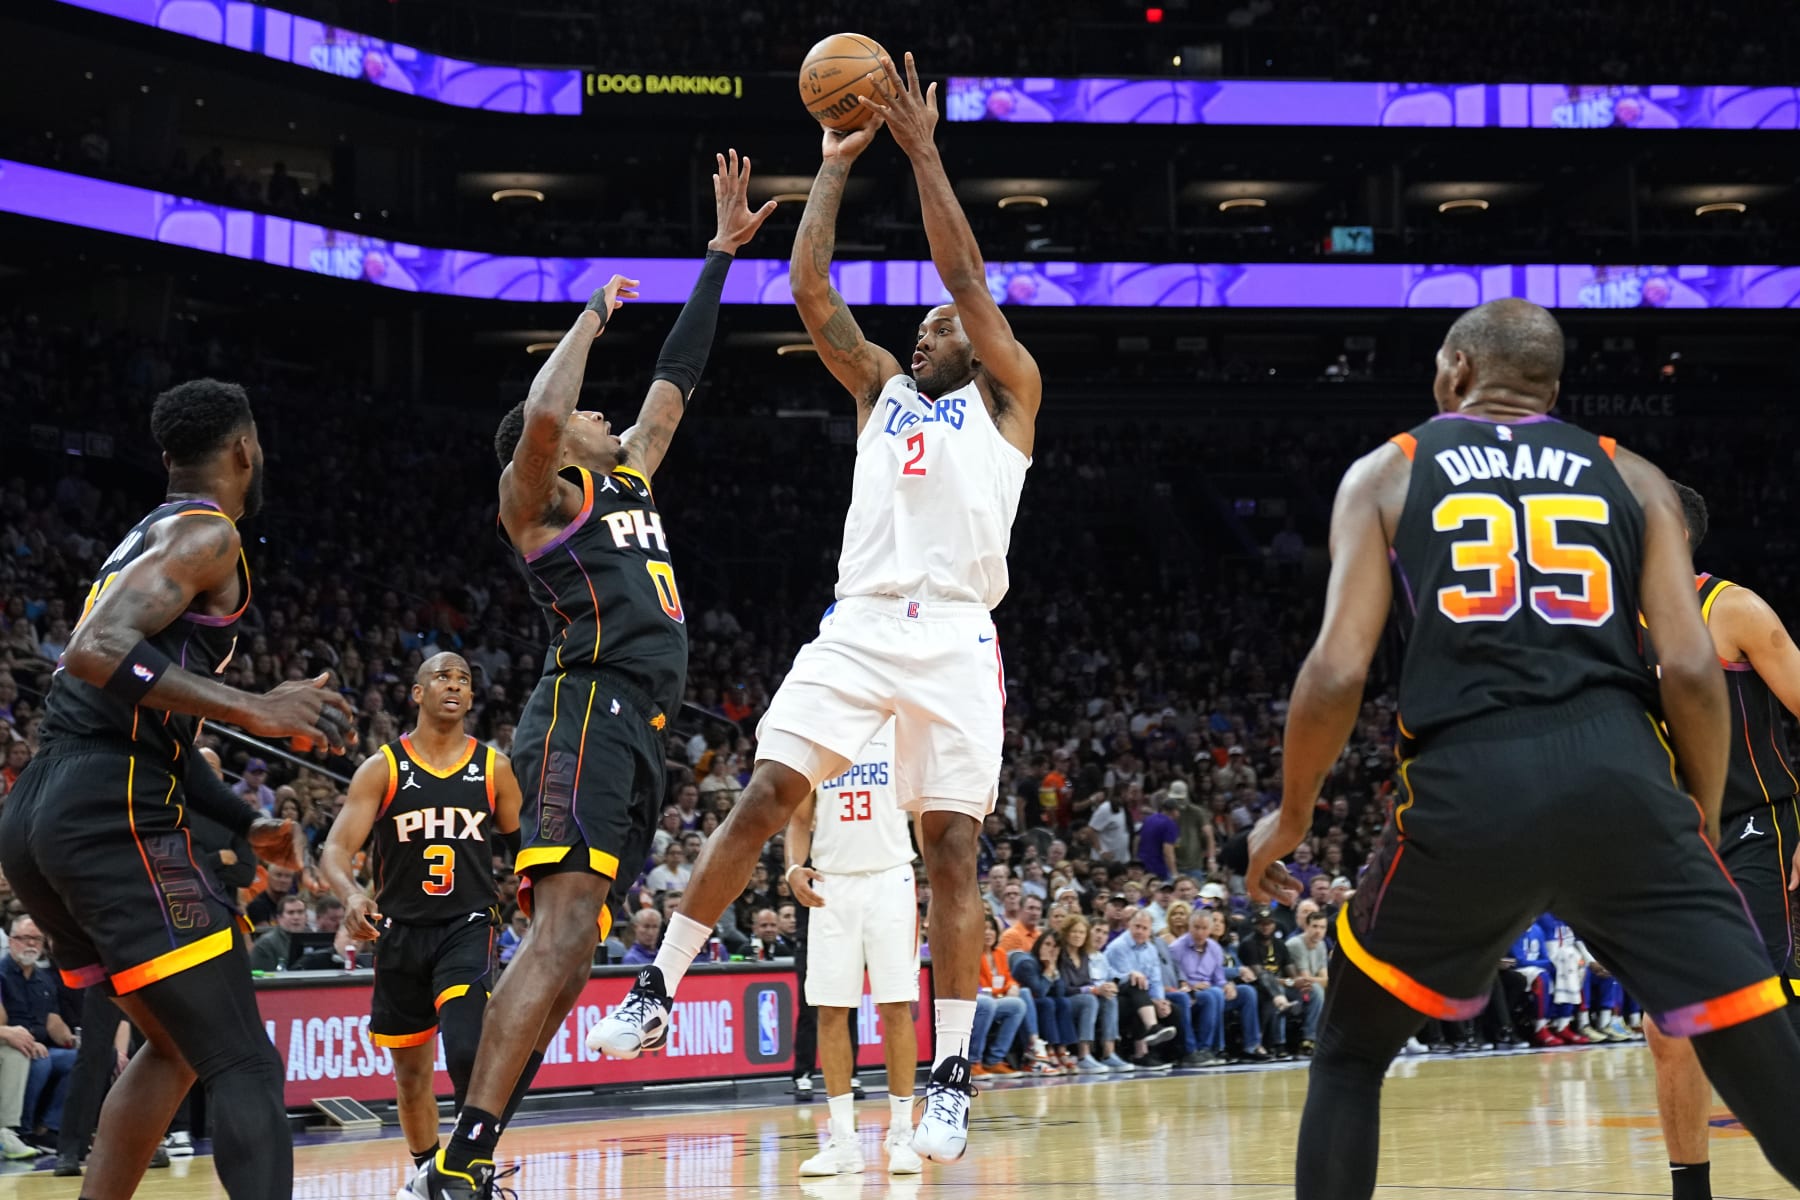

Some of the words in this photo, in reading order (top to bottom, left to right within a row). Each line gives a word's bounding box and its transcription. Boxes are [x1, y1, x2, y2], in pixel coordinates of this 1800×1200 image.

[598, 74, 642, 94] DOG
[646, 74, 732, 95] BARKING
[1568, 394, 1675, 418] TERRACE
[903, 431, 927, 476] 2
[1435, 444, 1593, 488] DURANT
[601, 509, 669, 553] PH
[1432, 492, 1615, 627] 35
[646, 558, 684, 624] 0
[400, 761, 410, 771] 6
[392, 806, 487, 843] PHX
[839, 791, 872, 822] 33
[422, 844, 455, 896] 3
